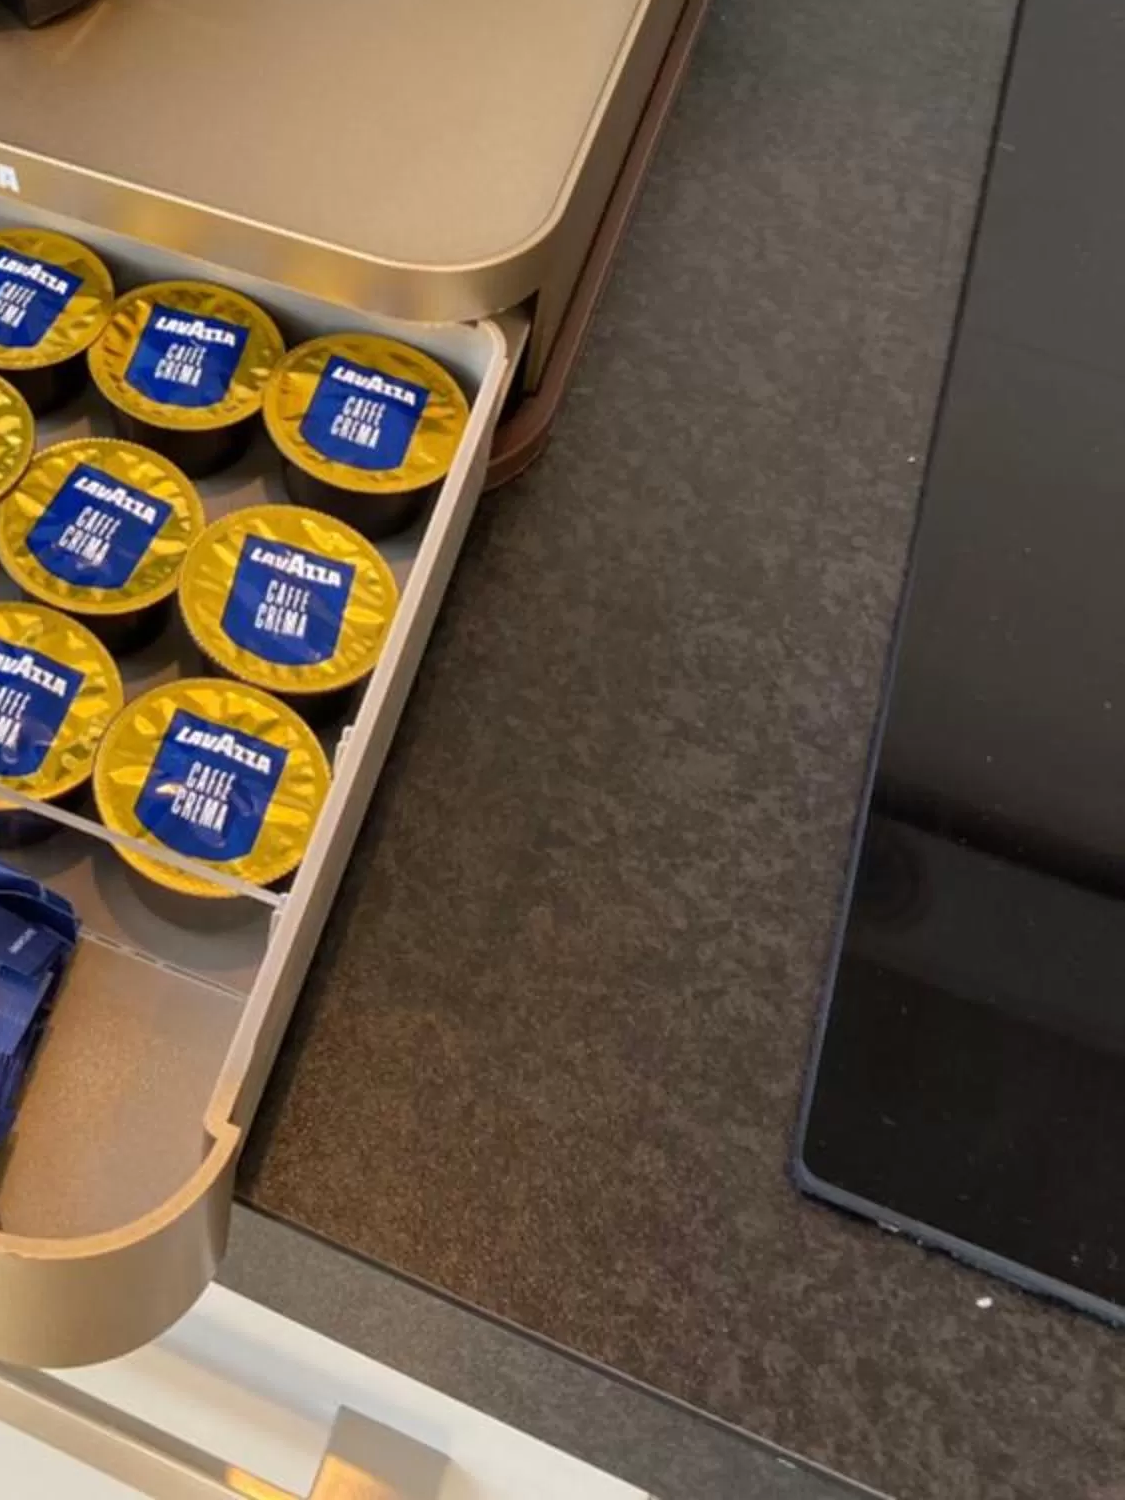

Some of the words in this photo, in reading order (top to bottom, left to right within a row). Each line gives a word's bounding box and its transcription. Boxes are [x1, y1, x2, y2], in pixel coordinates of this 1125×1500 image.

[155, 316, 236, 347] LAVAZZA
[154, 358, 202, 387] CREMA
[331, 365, 416, 407] LAVAZZA
[330, 413, 380, 448] CREMA
[74, 476, 158, 525] LAVAZZA
[59, 524, 110, 565] CREMA
[250, 547, 341, 588] LAVAZZA
[255, 602, 308, 638] CREMA
[175, 726, 272, 775] LAVAZZA
[171, 791, 229, 831] CREMA
